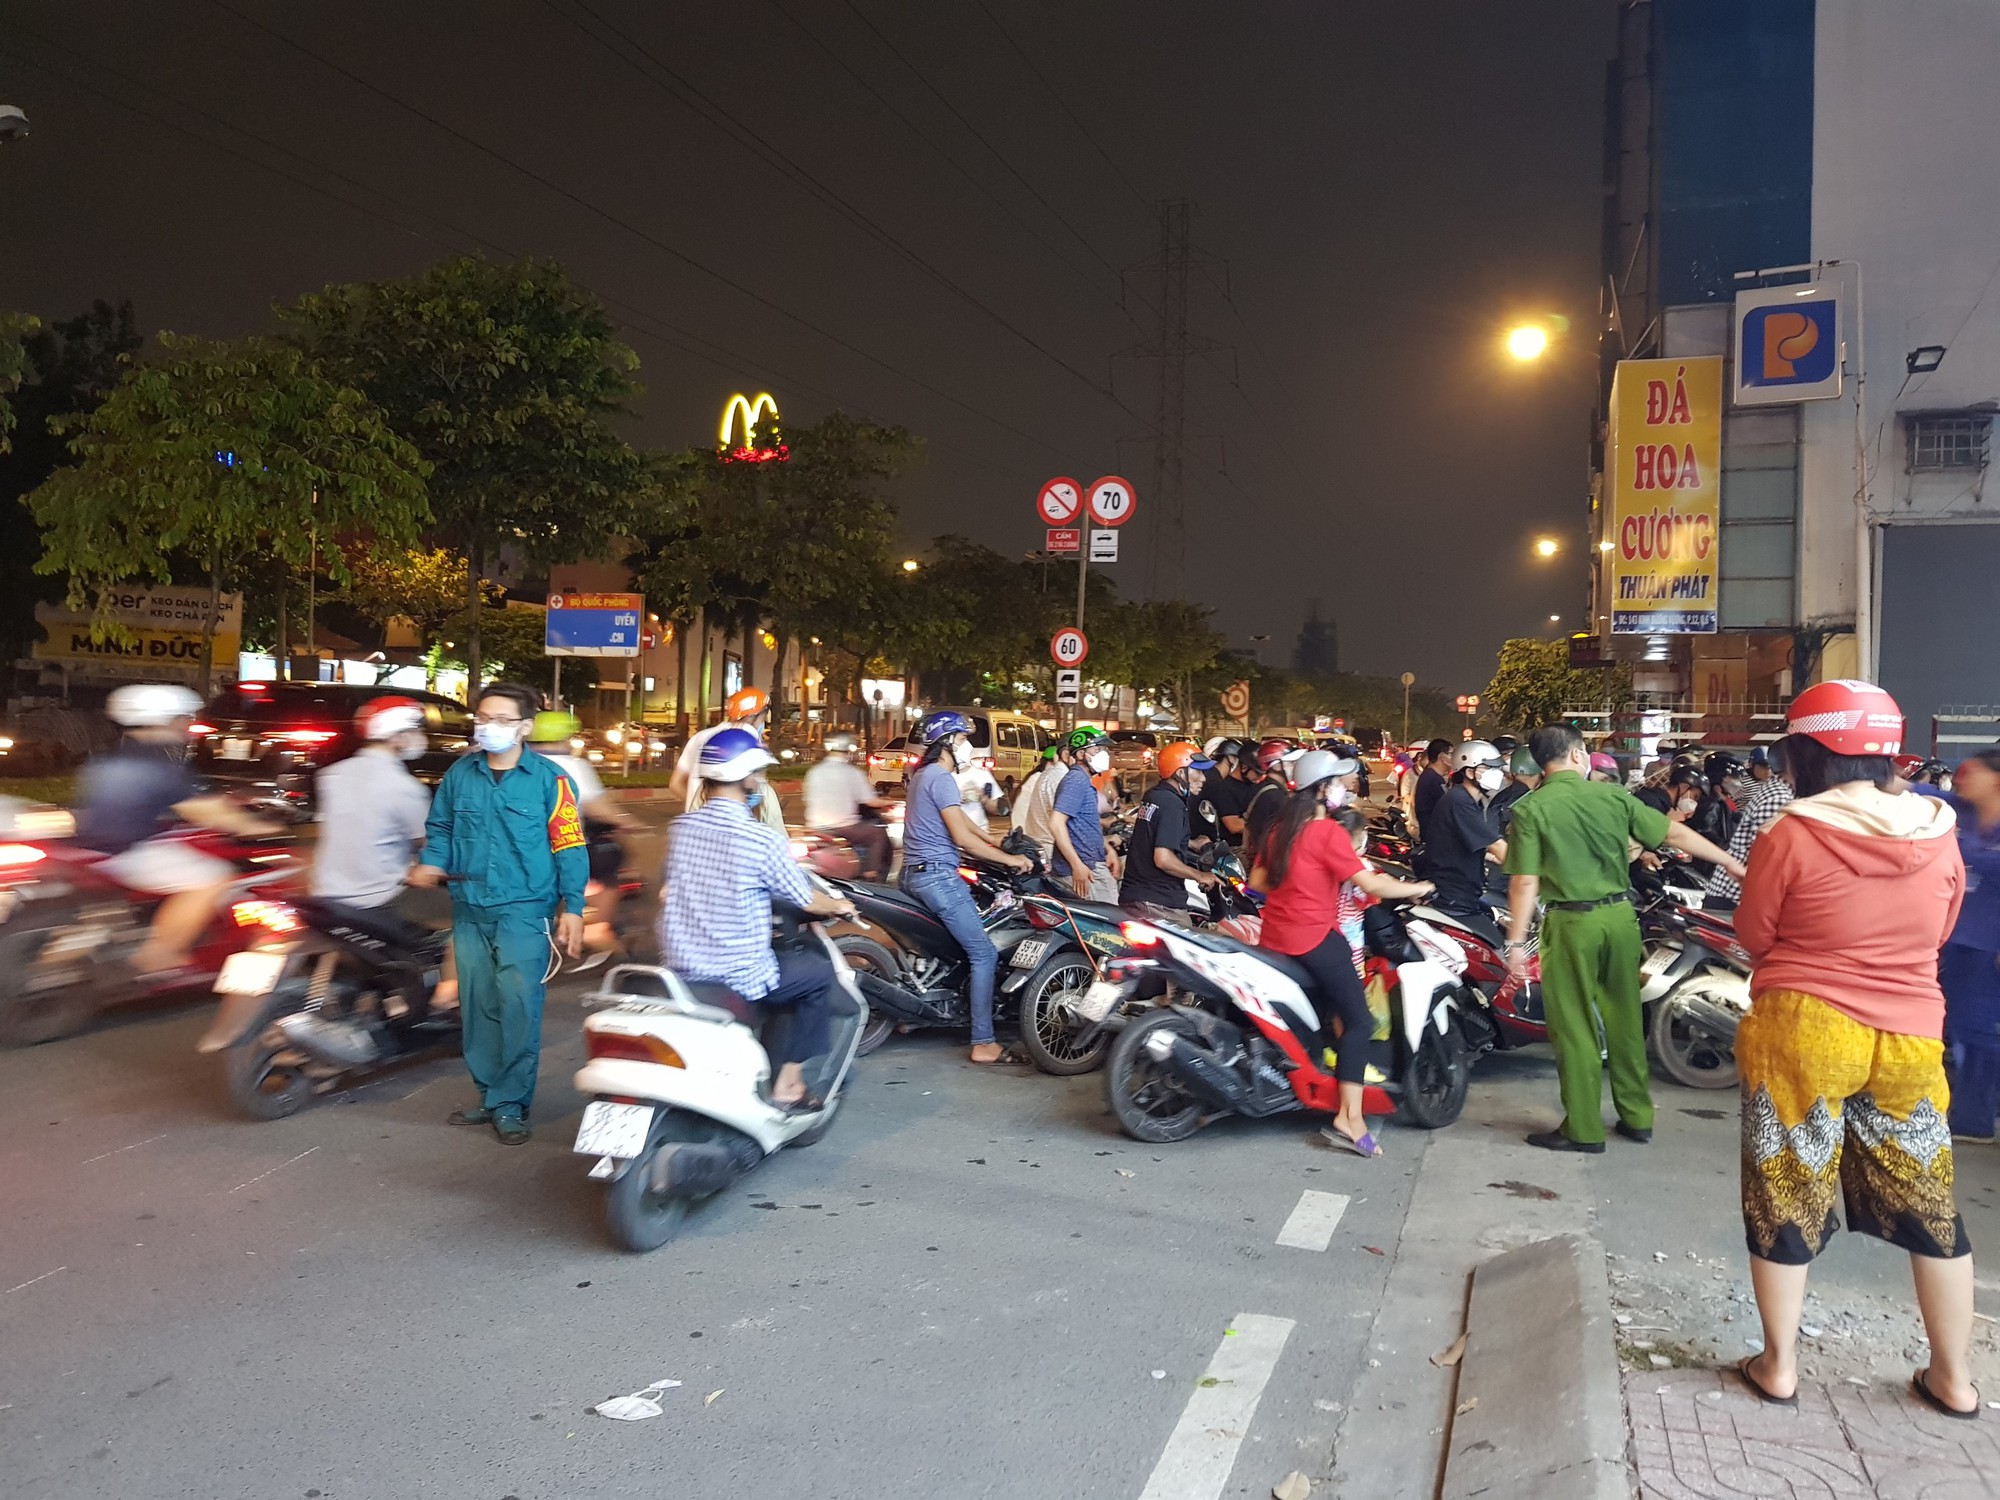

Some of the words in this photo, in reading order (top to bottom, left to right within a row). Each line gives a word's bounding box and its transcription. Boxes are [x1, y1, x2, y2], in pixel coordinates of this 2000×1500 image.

[1646, 365, 1692, 425] ĐÁ
[1633, 442, 1701, 490] HOA
[1103, 491, 1120, 511] 70
[1620, 506, 1711, 562] CƯƠNG
[1619, 569, 1668, 606] THUẬN
[1670, 568, 1710, 599] PHÁT
[150, 597, 173, 606] KEO
[175, 597, 199, 608] DÁN
[201, 601, 234, 611] GCH
[150, 609, 173, 618] KEO
[1061, 639, 1076, 655] 60
